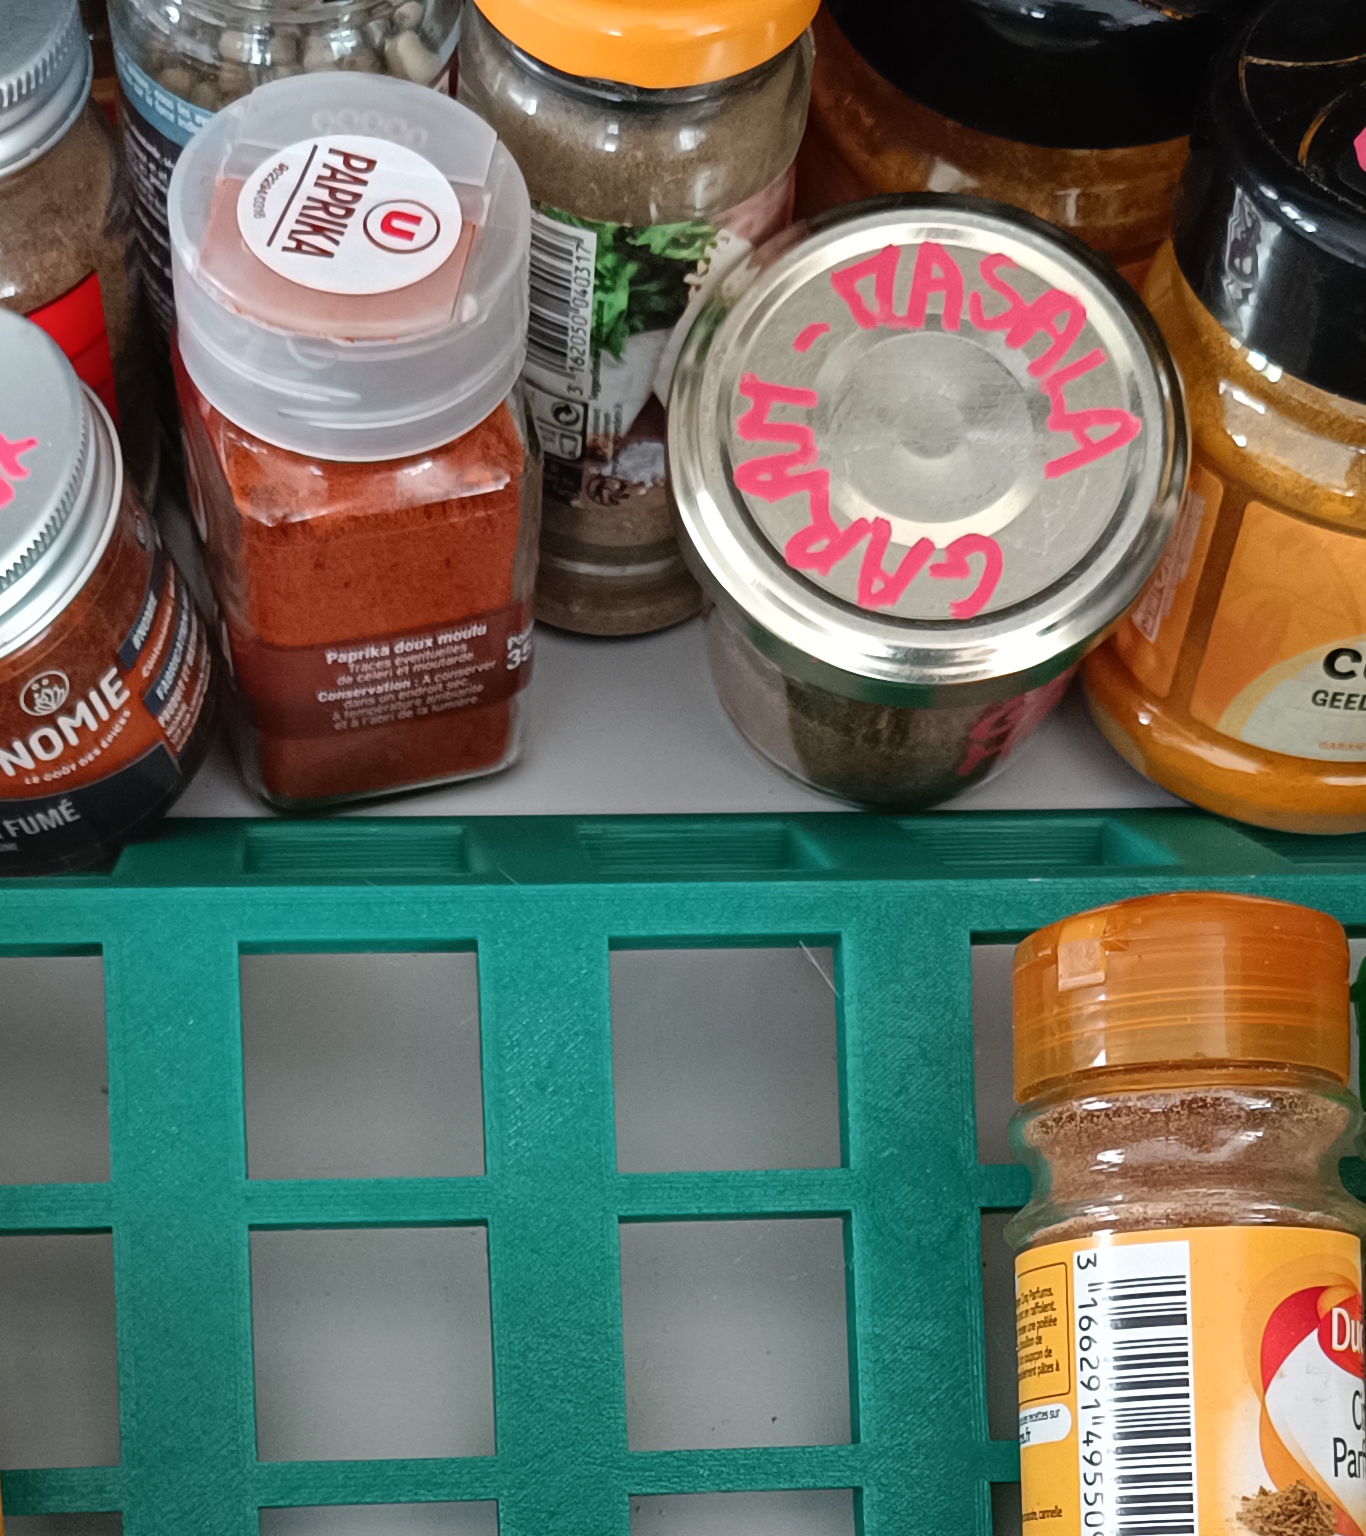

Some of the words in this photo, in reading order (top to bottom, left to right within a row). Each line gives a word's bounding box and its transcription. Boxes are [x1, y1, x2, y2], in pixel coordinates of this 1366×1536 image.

[281, 147, 377, 259] PAPRIKA
[325, 645, 390, 664] Paprika
[394, 636, 433, 654] doux
[437, 624, 487, 645] moulu
[3, 798, 81, 837] FUMÉ
[1077, 1296, 1103, 1412] 166291
